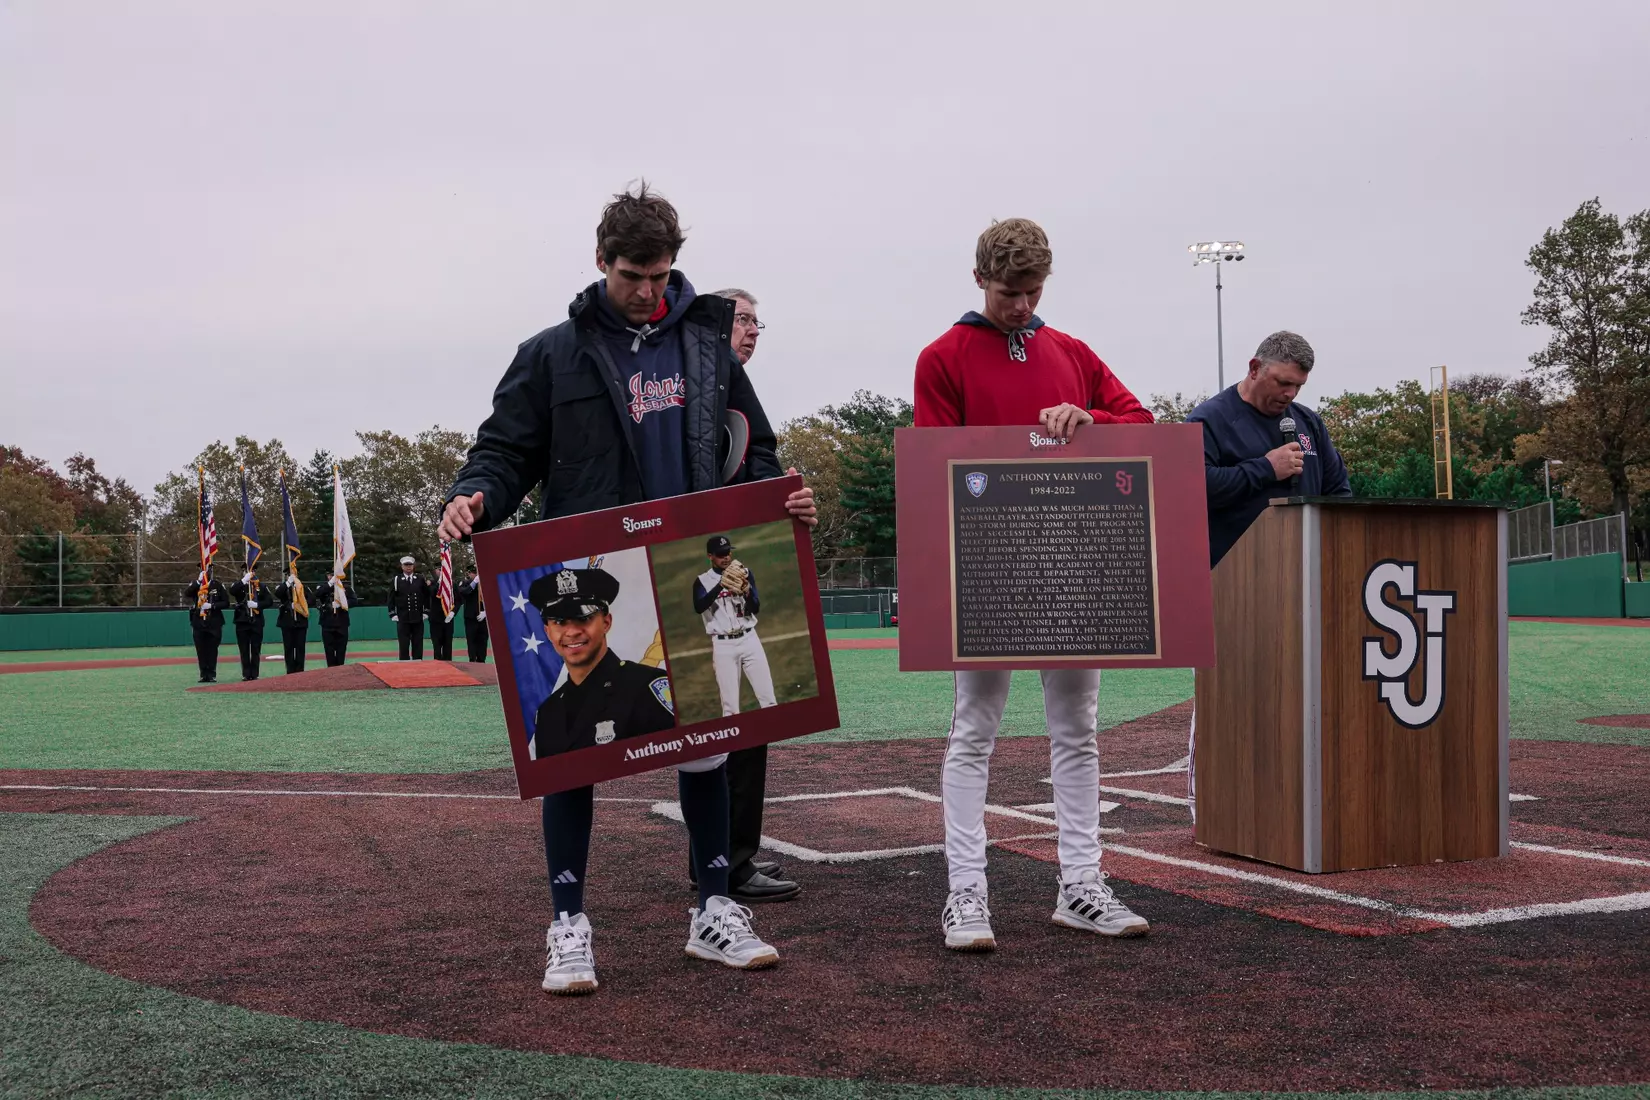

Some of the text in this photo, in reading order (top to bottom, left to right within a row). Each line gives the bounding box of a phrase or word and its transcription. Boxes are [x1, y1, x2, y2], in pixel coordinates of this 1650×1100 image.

[999, 472, 1102, 482] ANTHONY VARVARO
[1030, 486, 1076, 494] 1984-2022
[624, 726, 740, 761] Anthony Varvaro
